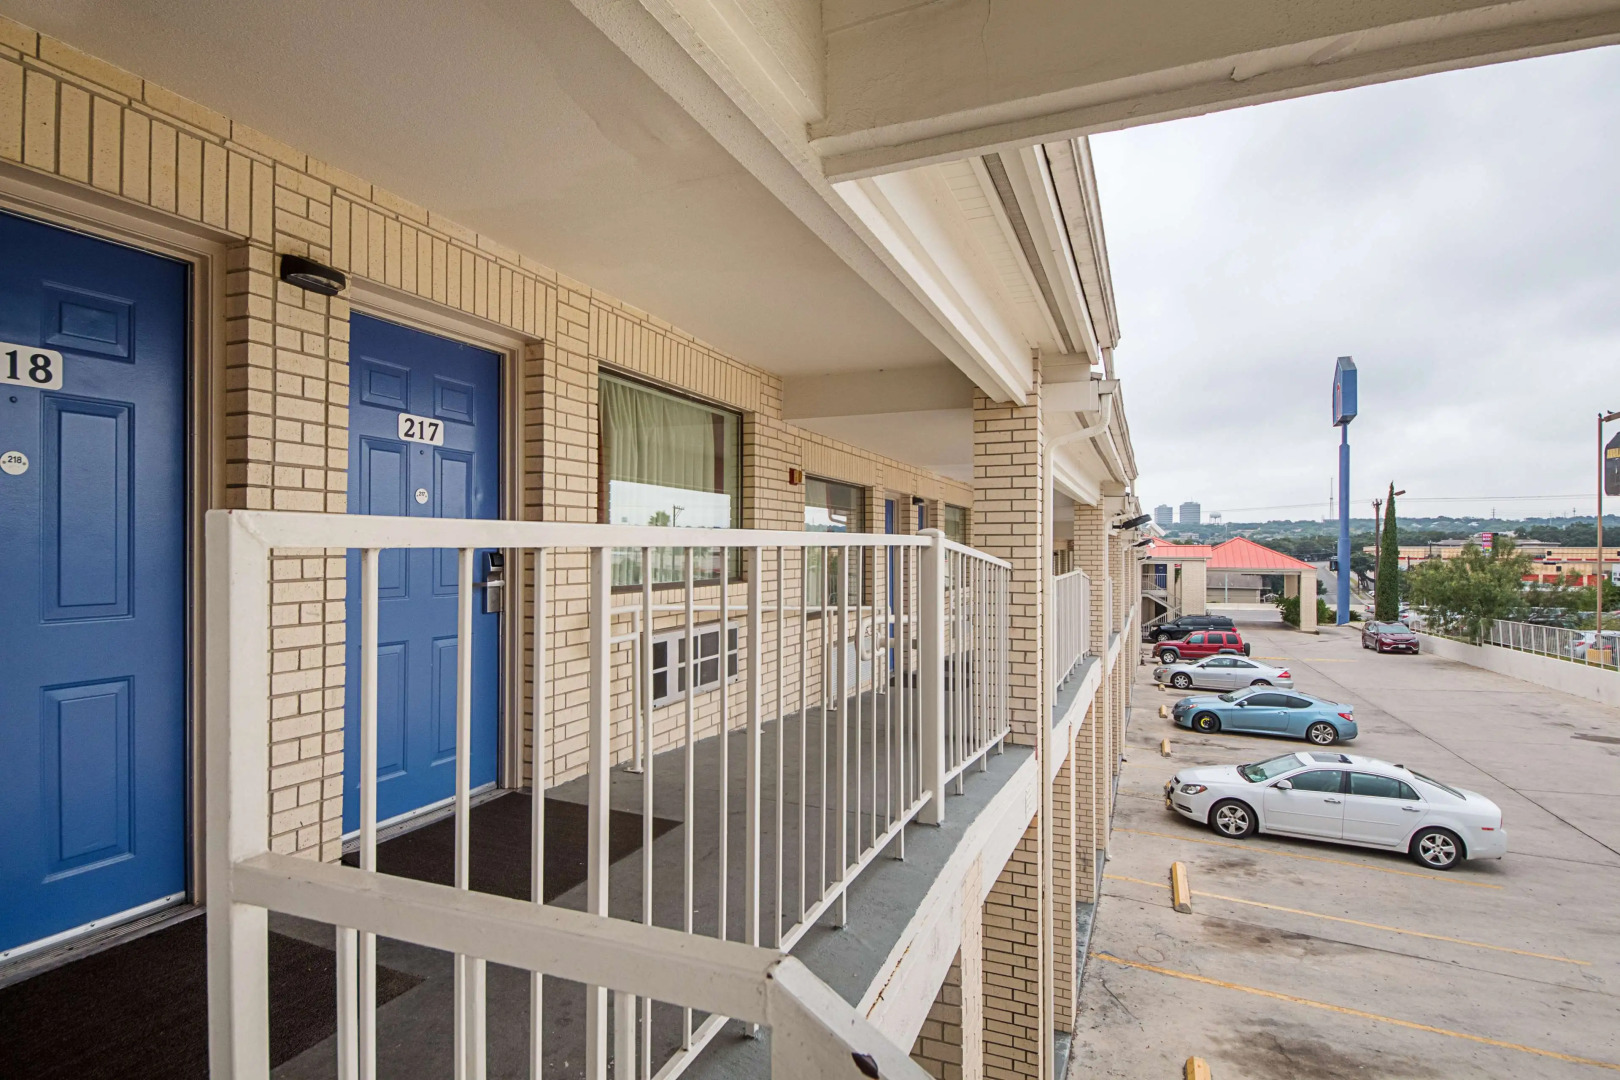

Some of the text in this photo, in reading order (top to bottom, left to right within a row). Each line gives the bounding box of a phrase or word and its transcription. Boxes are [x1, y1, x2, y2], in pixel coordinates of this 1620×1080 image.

[5, 350, 53, 383] 18
[404, 418, 439, 441] 217
[7, 455, 22, 463] 218
